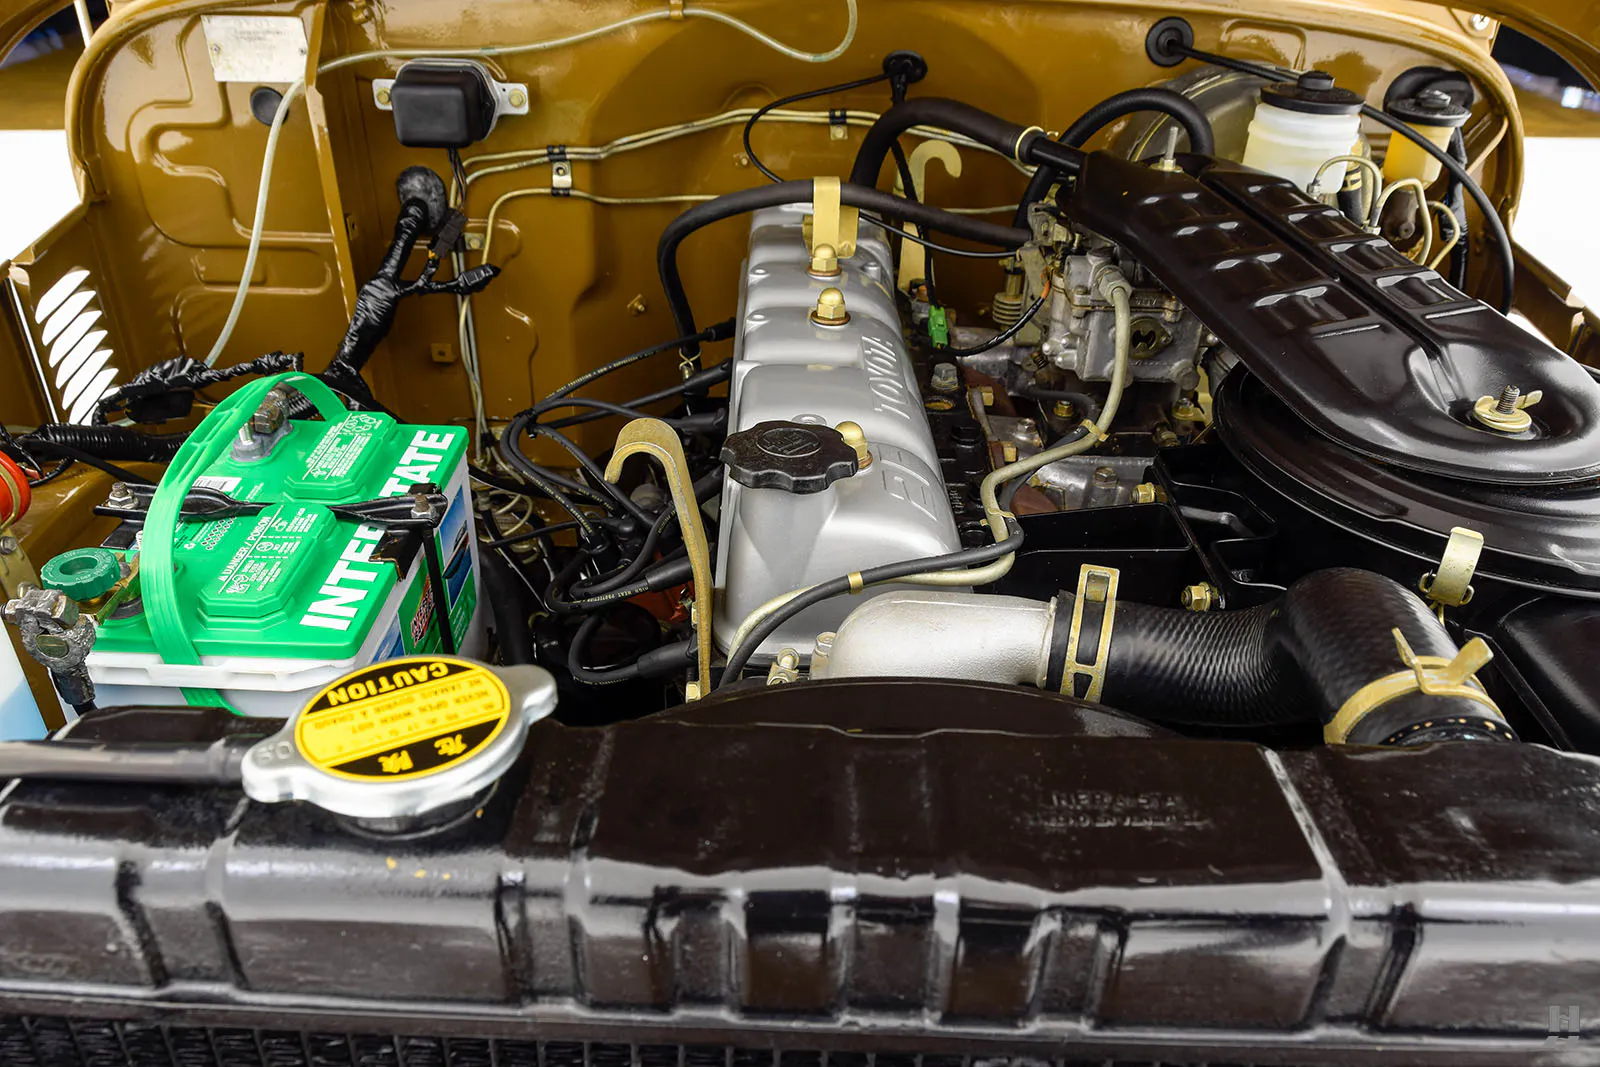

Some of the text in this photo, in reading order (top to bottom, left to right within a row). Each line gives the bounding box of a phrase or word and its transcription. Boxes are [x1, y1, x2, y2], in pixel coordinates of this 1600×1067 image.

[225, 546, 250, 575] DANGER
[248, 515, 271, 541] POISON
[300, 430, 455, 631] INTETATE
[326, 662, 449, 706] CAUTION
